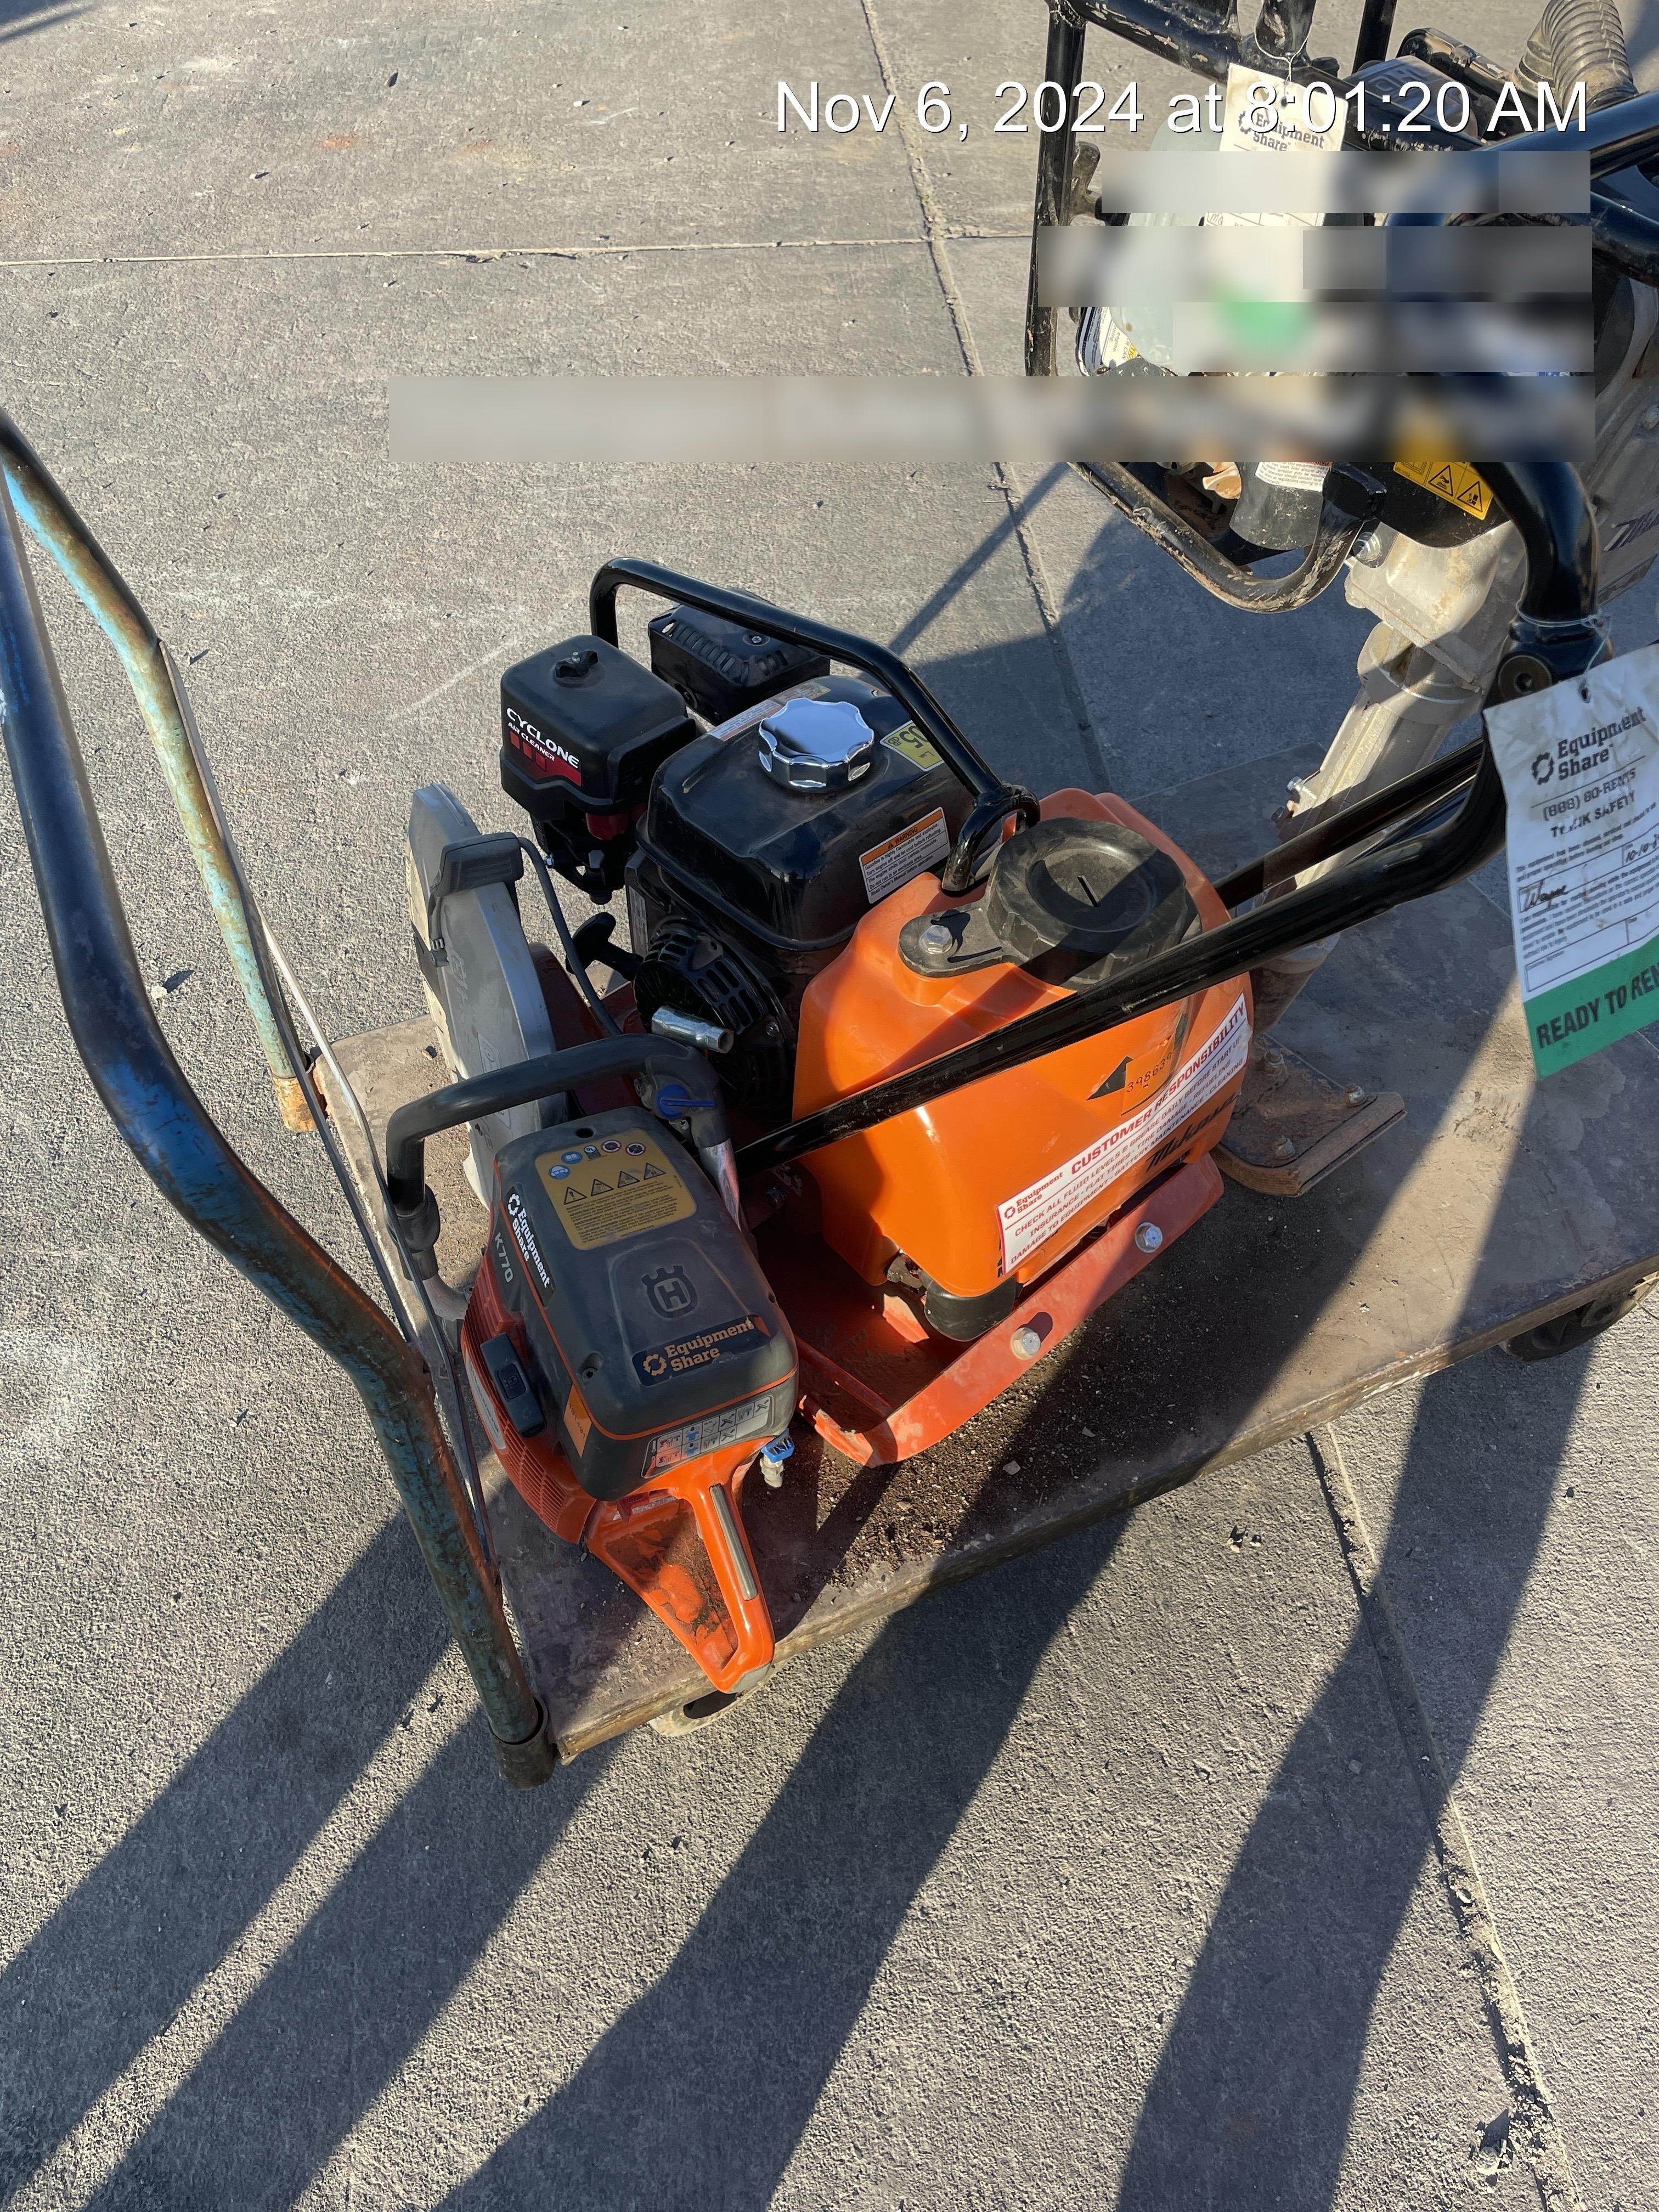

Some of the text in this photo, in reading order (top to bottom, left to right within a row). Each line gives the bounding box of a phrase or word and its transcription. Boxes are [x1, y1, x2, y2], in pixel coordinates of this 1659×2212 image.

[507, 708, 579, 768] CYCLONE
[508, 722, 555, 761] AIR CLEANER
[888, 736, 901, 746] dB
[1558, 707, 1646, 759] Equipment
[1559, 748, 1609, 780] Share
[876, 861, 887, 872] engine
[914, 839, 925, 848] before
[894, 827, 918, 844] WARNING
[865, 859, 880, 870] Gasoline
[885, 850, 895, 859] highly
[876, 870, 888, 879] engine
[871, 888, 880, 896] Read
[894, 872, 906, 883] Manual
[907, 865, 917, 874] before
[1537, 998, 1599, 1048] READY
[1605, 985, 1627, 1014] TO
[1071, 1001, 1244, 1174] CUSTOMER RESPONSIBILITY
[1011, 1232, 1045, 1264] DAMAGE
[1048, 1220, 1059, 1232] TO
[1061, 1181, 1108, 1221] EQUIPMENT
[1115, 1148, 1149, 1176] BATTERY
[1151, 1098, 1203, 1146] MAINTENANCE
[1210, 1058, 1243, 1094] CLEANING
[1015, 1211, 1045, 1236] CHECK
[1047, 1198, 1063, 1212] ALL
[1064, 1175, 1089, 1198] FLUID
[1091, 1153, 1120, 1178] LEVELS
[1130, 1119, 1159, 1147] GREASE
[1162, 1099, 1183, 1122] DAILY
[1184, 1073, 1210, 1097] BEFORE
[1212, 1047, 1232, 1070] START
[1030, 1060, 1231, 1237] INSURANCE FLAT TIRES TIRE DAMAGE REFUELING
[1016, 1172, 1063, 1206] Equipment
[1017, 1194, 1042, 1214] Share
[495, 1232, 513, 1283] K770
[512, 1218, 529, 1261] Share
[518, 1208, 550, 1288] Equipment
[664, 1317, 754, 1358] Equipment
[670, 1347, 720, 1372] Share
